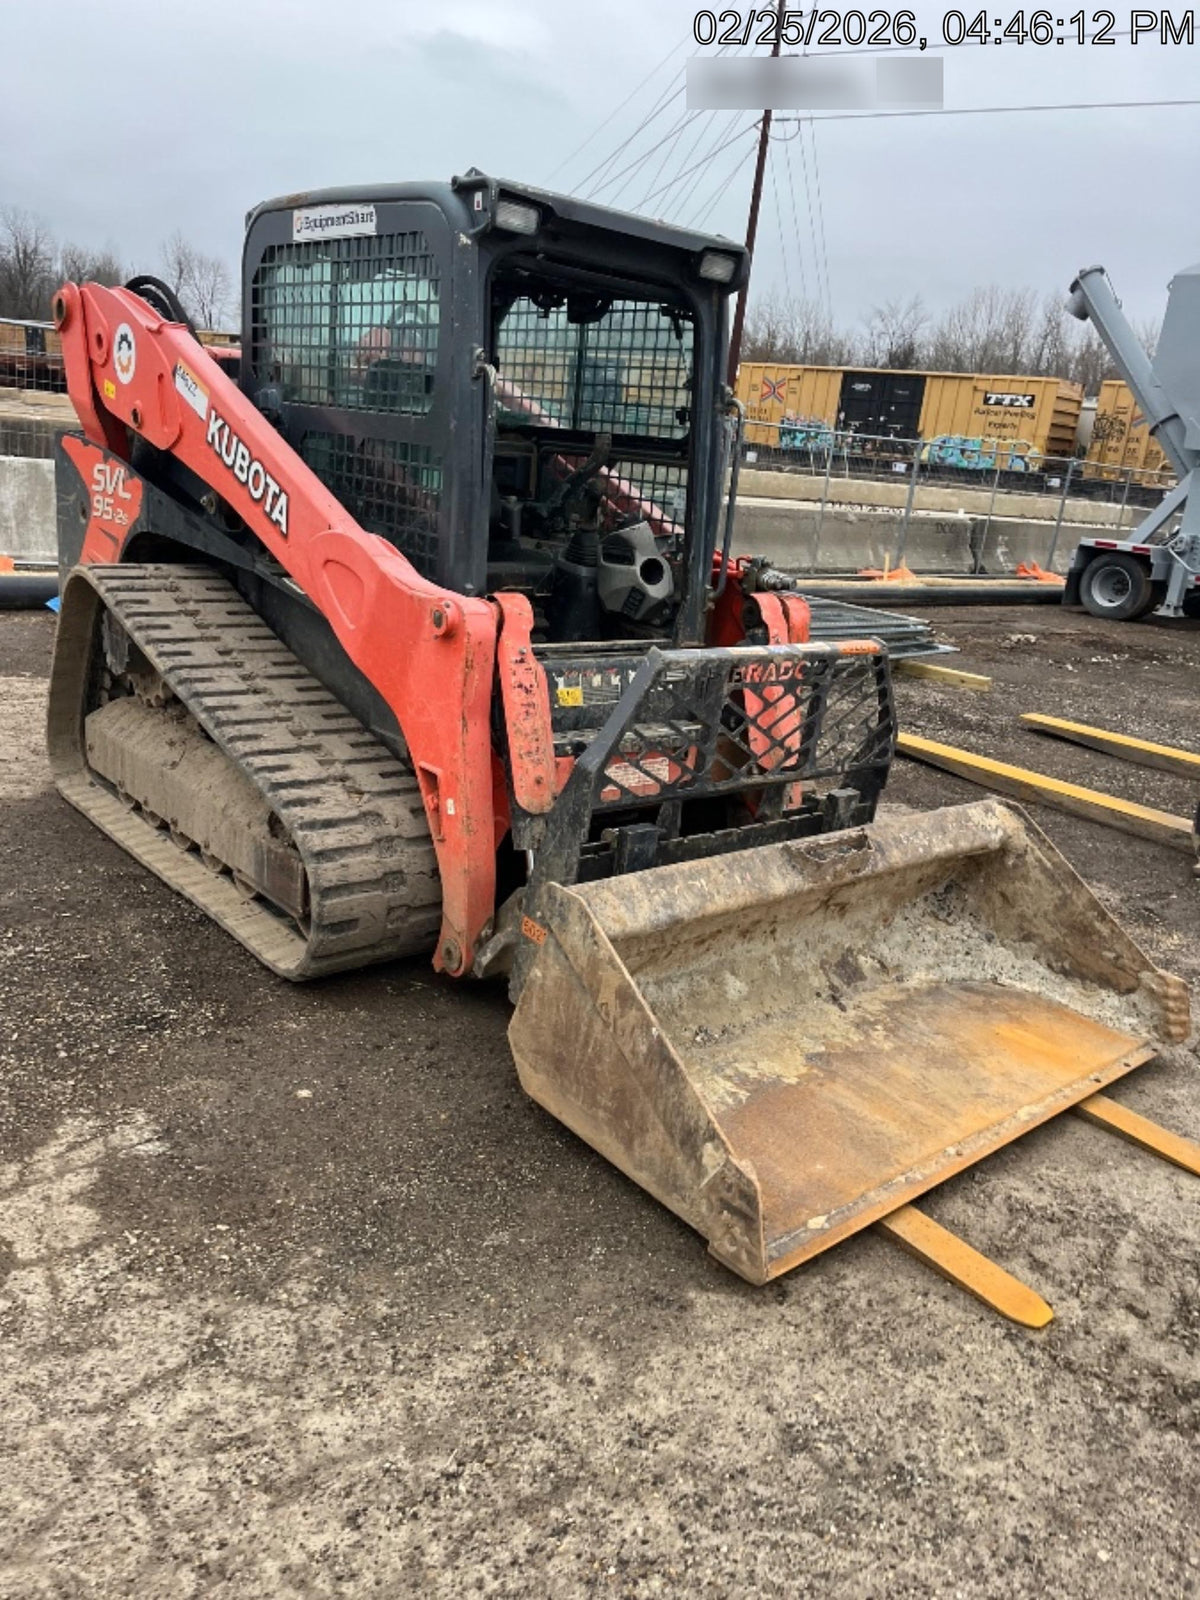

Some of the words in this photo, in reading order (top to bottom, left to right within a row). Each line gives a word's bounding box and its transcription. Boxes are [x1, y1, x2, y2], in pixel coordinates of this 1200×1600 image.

[986, 393, 1032, 406] TTX
[92, 463, 132, 499] SVL
[206, 408, 289, 537] KUBOTA
[729, 659, 829, 684] BRADCO
